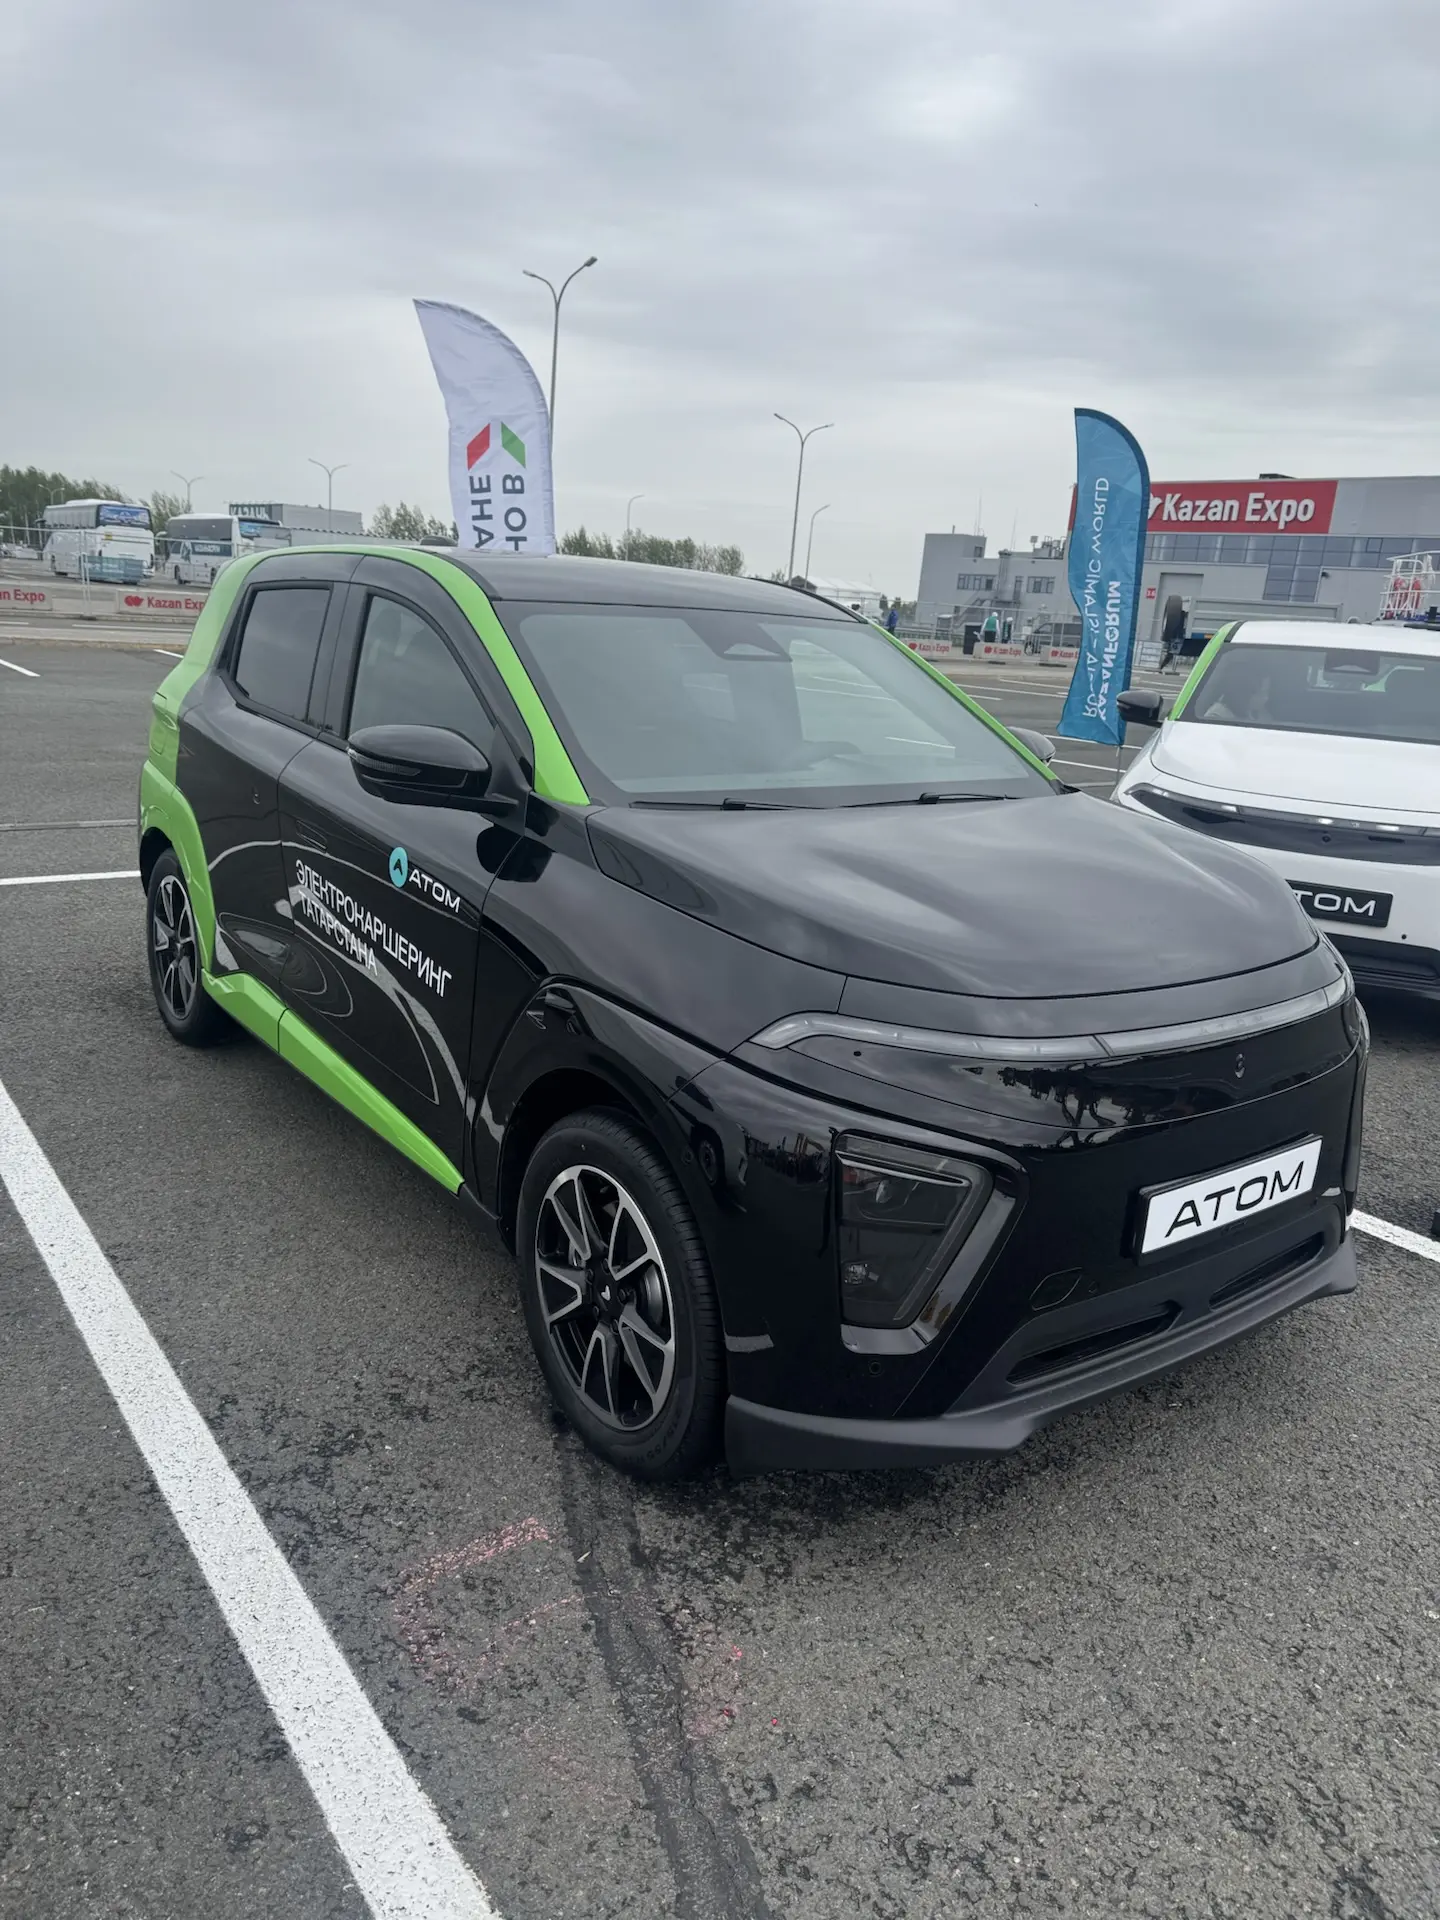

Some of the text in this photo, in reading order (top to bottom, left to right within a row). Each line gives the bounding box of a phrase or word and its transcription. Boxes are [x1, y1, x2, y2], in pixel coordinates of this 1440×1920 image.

[1162, 492, 1316, 530] Kazan Expo
[13, 588, 46, 605] Expo
[147, 596, 206, 610] Kazan Exp
[409, 869, 461, 913] ATOM
[1293, 890, 1376, 917] TOM
[296, 859, 452, 997] ЭЛЕКТРОКАРШЕРИНГ
[299, 889, 378, 976] ТАТАРСТАНА
[1165, 1160, 1305, 1238] ATOM
